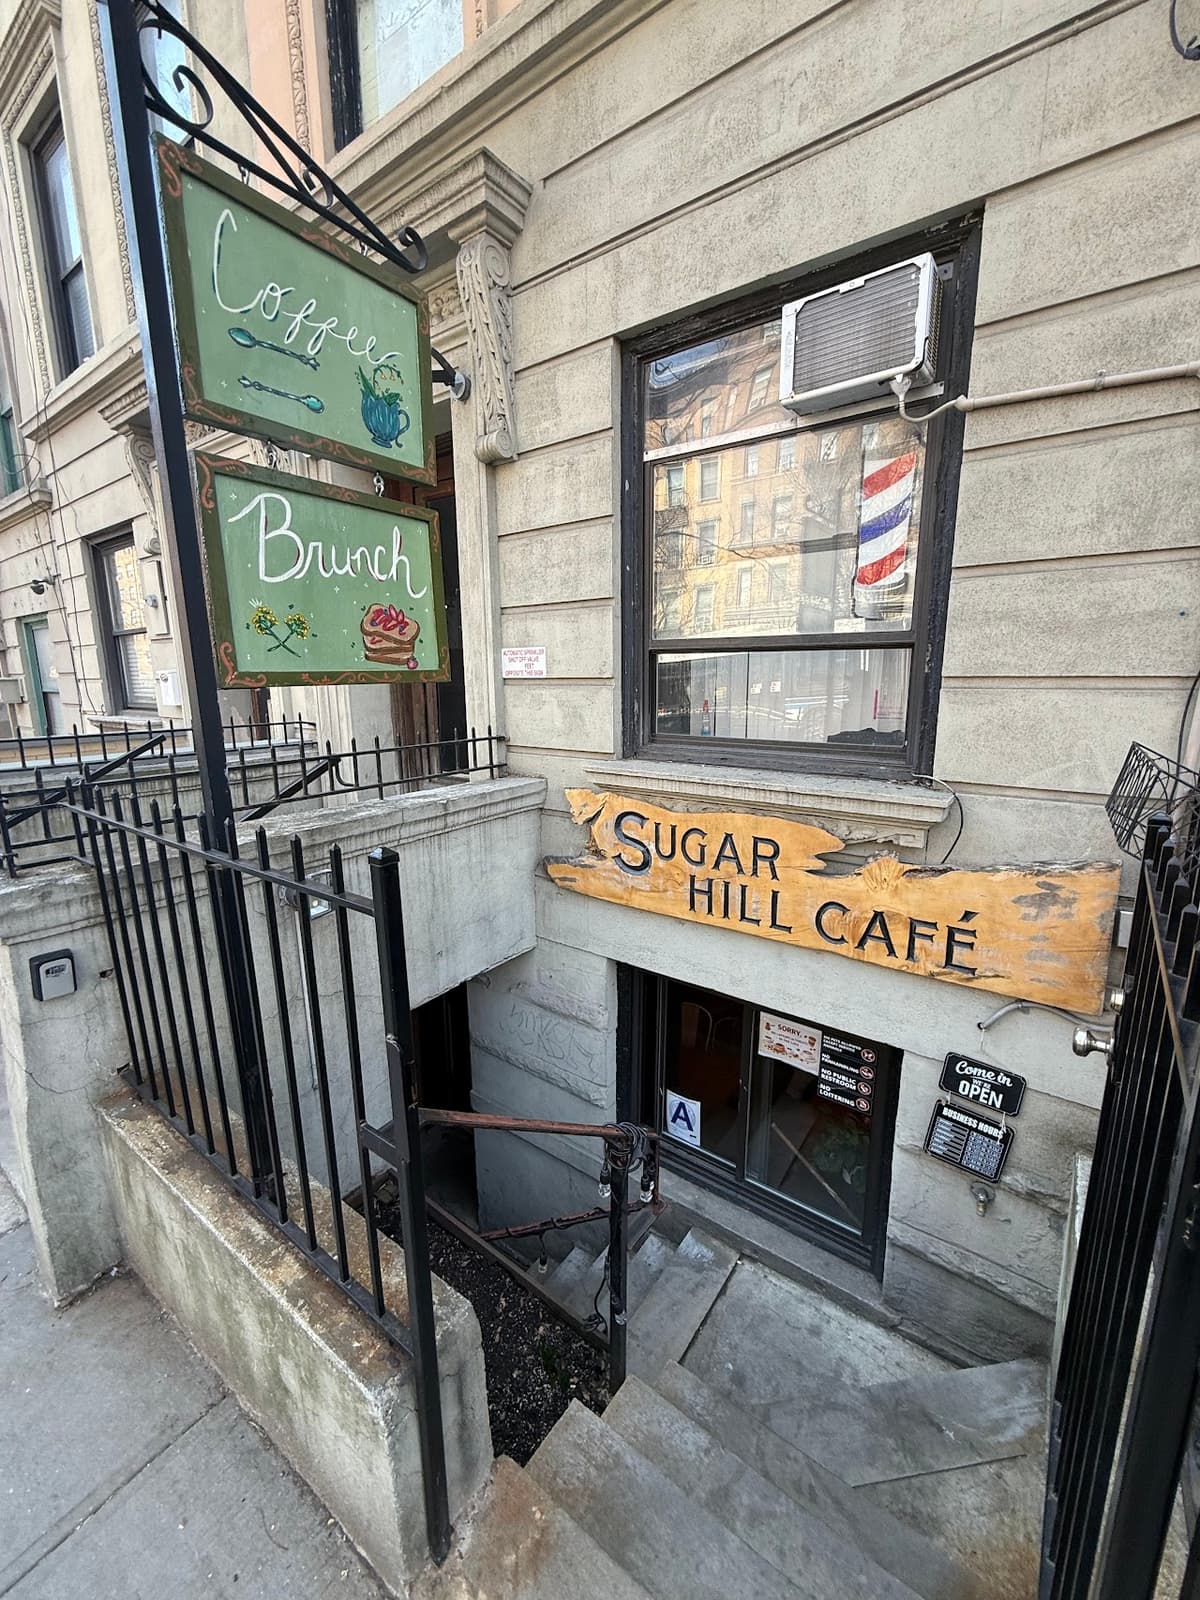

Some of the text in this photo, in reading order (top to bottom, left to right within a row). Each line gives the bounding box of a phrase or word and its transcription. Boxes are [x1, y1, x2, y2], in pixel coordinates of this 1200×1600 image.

[213, 209, 404, 365] Coffee
[228, 493, 428, 599] Brunch
[611, 811, 782, 881] SUGAR
[688, 873, 978, 976] HILL CAFÉ
[820, 1083, 831, 1091] NO
[821, 1068, 856, 1084] NO PUBLIC
[821, 1074, 856, 1090] RESTROOM
[955, 1061, 1013, 1087] Come in
[819, 1089, 855, 1107] LOITERING
[958, 1081, 1003, 1109] OPEN
[671, 1101, 694, 1132] A
[942, 1107, 1004, 1139] BUSINESS HOURS
